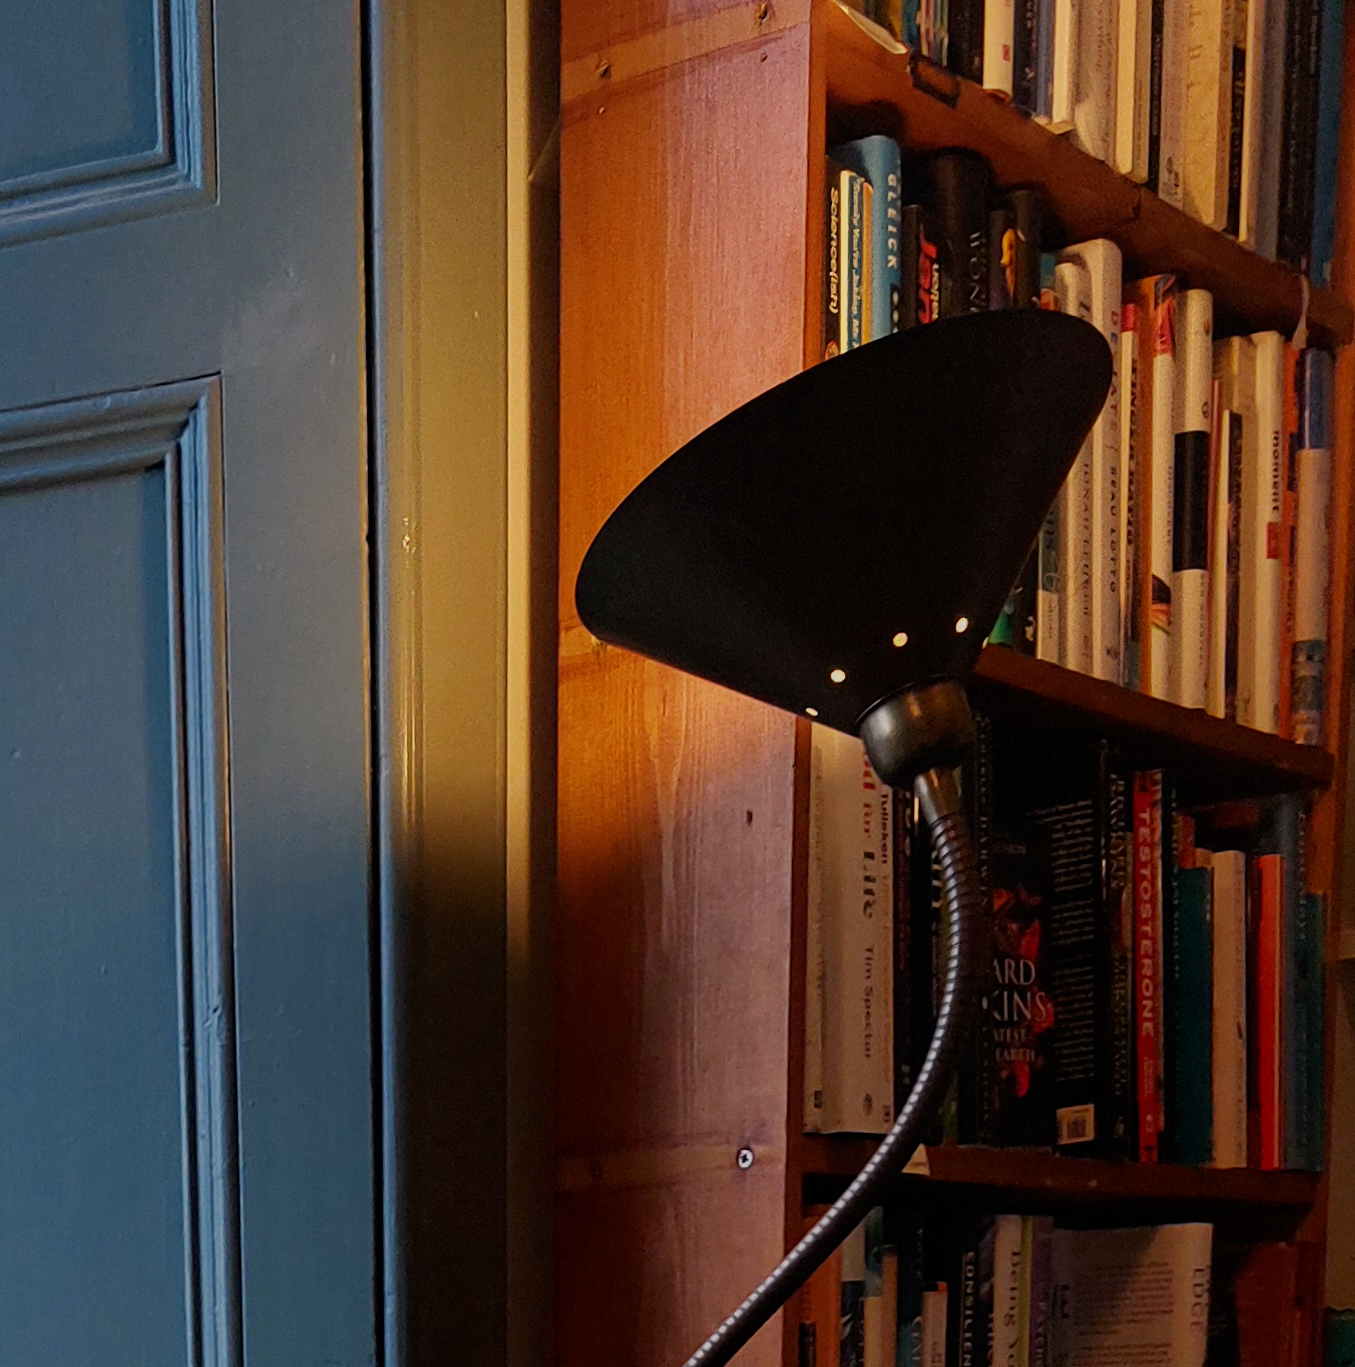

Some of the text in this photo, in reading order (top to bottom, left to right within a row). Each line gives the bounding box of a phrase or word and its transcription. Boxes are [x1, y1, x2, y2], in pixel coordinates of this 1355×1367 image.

[829, 187, 839, 314] Science(ish)
[887, 174, 898, 270] GLEICK
[862, 850, 877, 919] Life
[1138, 810, 1154, 1038] TESTOSTERONE
[864, 944, 876, 981] Tim
[992, 958, 1036, 986] ARD
[862, 987, 876, 1060] Spector
[1004, 1251, 1021, 1329] Being
